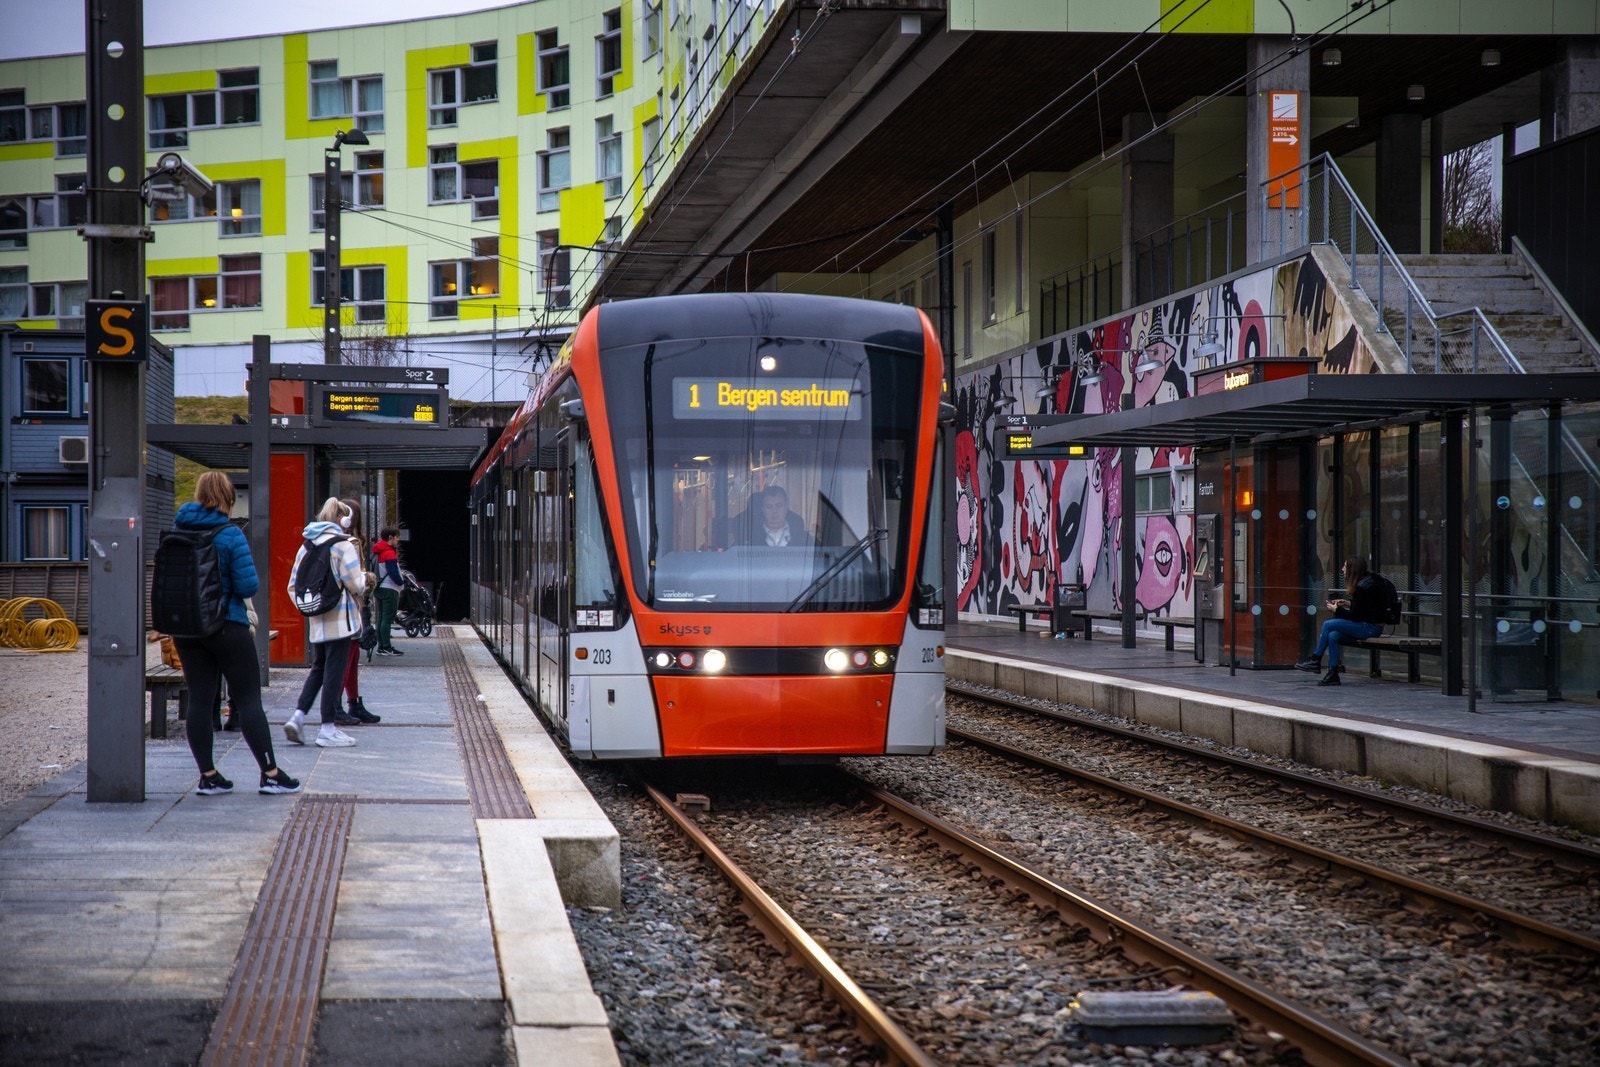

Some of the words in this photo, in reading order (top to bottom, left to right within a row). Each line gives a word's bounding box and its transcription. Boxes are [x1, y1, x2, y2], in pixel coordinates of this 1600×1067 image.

[99, 306, 135, 356] S
[405, 368, 425, 379] Spor
[425, 370, 434, 381] 2
[329, 394, 353, 404] Bergen
[353, 395, 380, 403] sentrum
[689, 384, 700, 408] 1
[718, 382, 778, 411] Bergen
[780, 383, 850, 407] sentrum
[329, 402, 353, 412] Bergen
[353, 403, 380, 411] sentrum
[1007, 415, 1021, 424] Spor
[1022, 416, 1028, 425] 1
[659, 622, 701, 637] skyss
[593, 648, 612, 665] 203
[922, 647, 935, 663] 203
